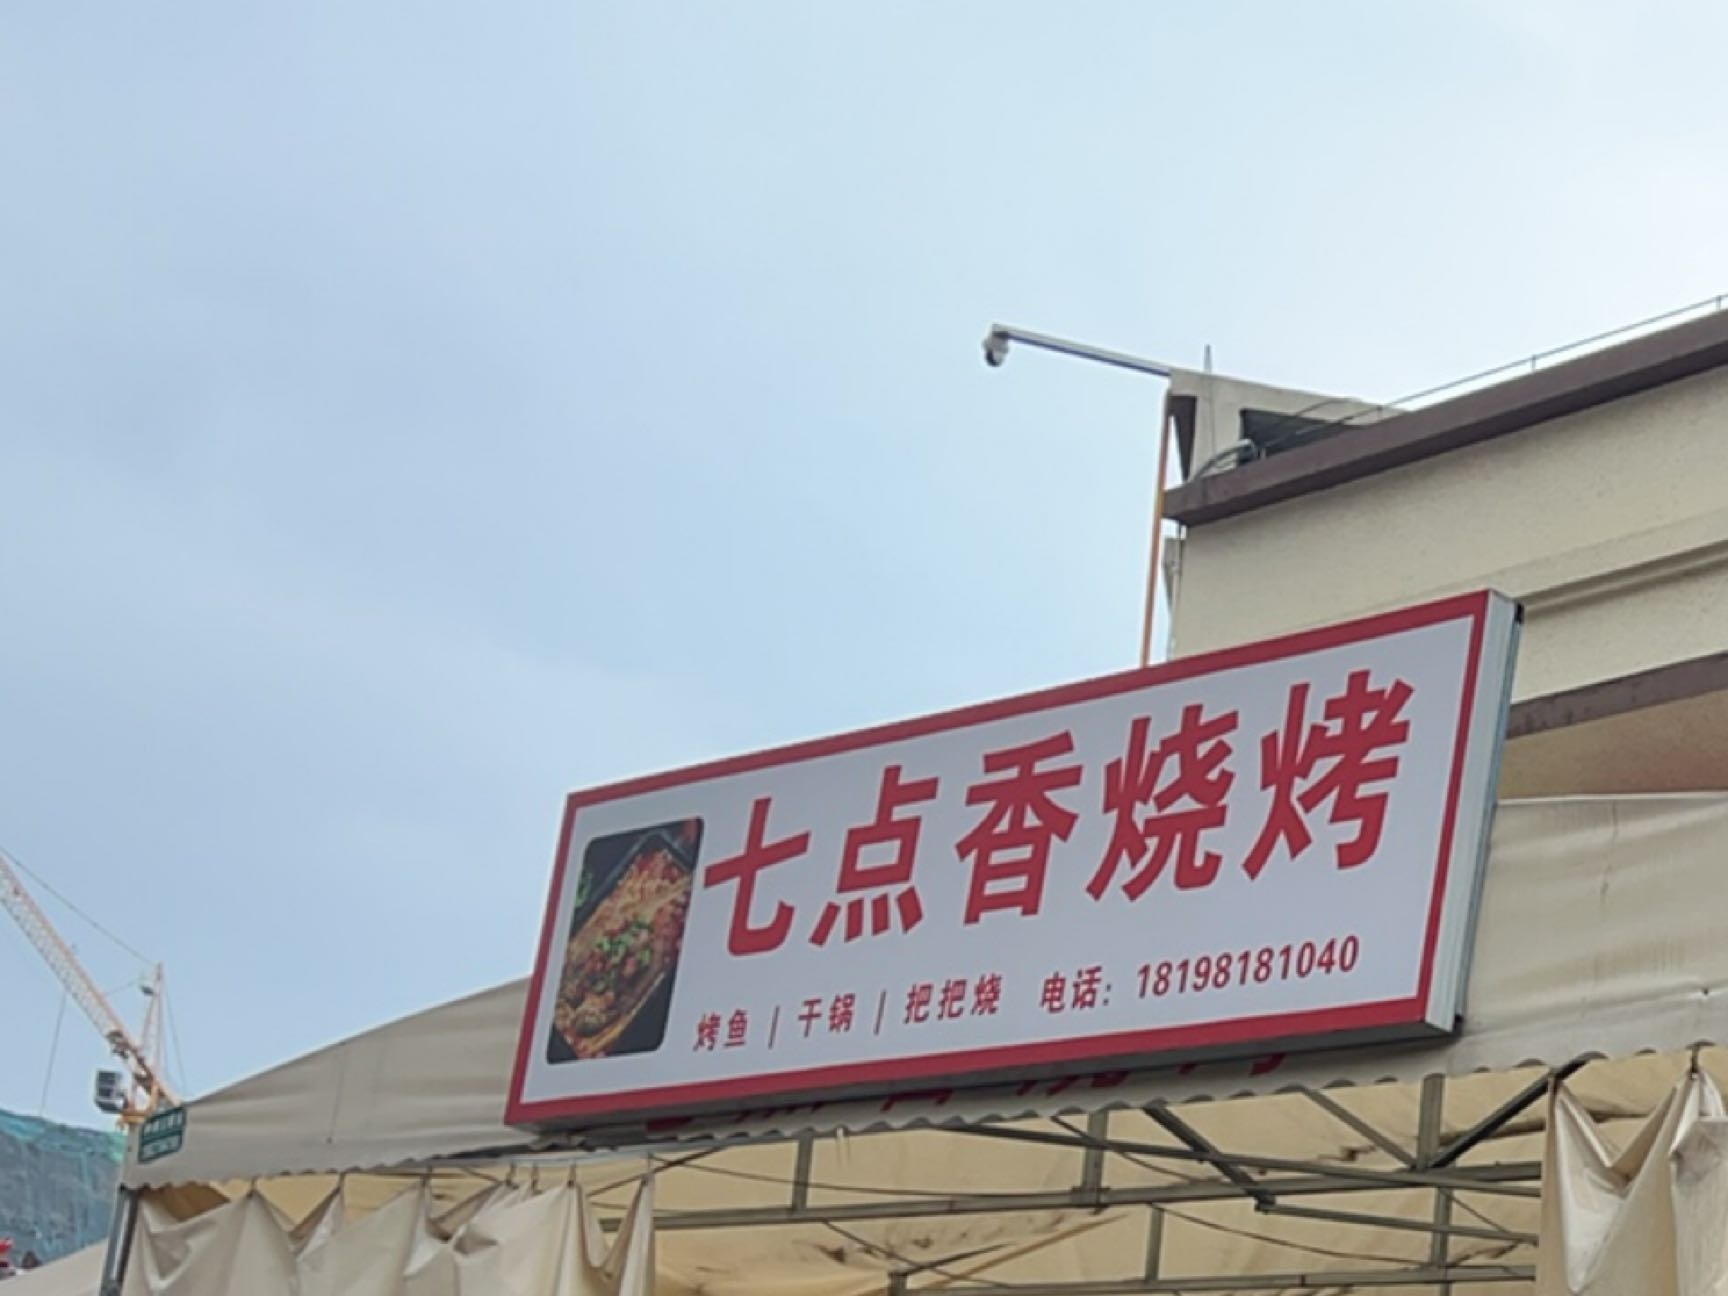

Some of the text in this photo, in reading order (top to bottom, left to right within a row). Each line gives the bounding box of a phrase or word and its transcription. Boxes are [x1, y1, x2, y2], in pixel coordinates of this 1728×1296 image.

[701, 667, 1415, 957] 七点香烧烤
[693, 1012, 750, 1053] 烤鱼
[797, 994, 854, 1039] 干锅
[902, 972, 1004, 1026] 把把烧
[1135, 933, 1361, 1000] 18198181040
